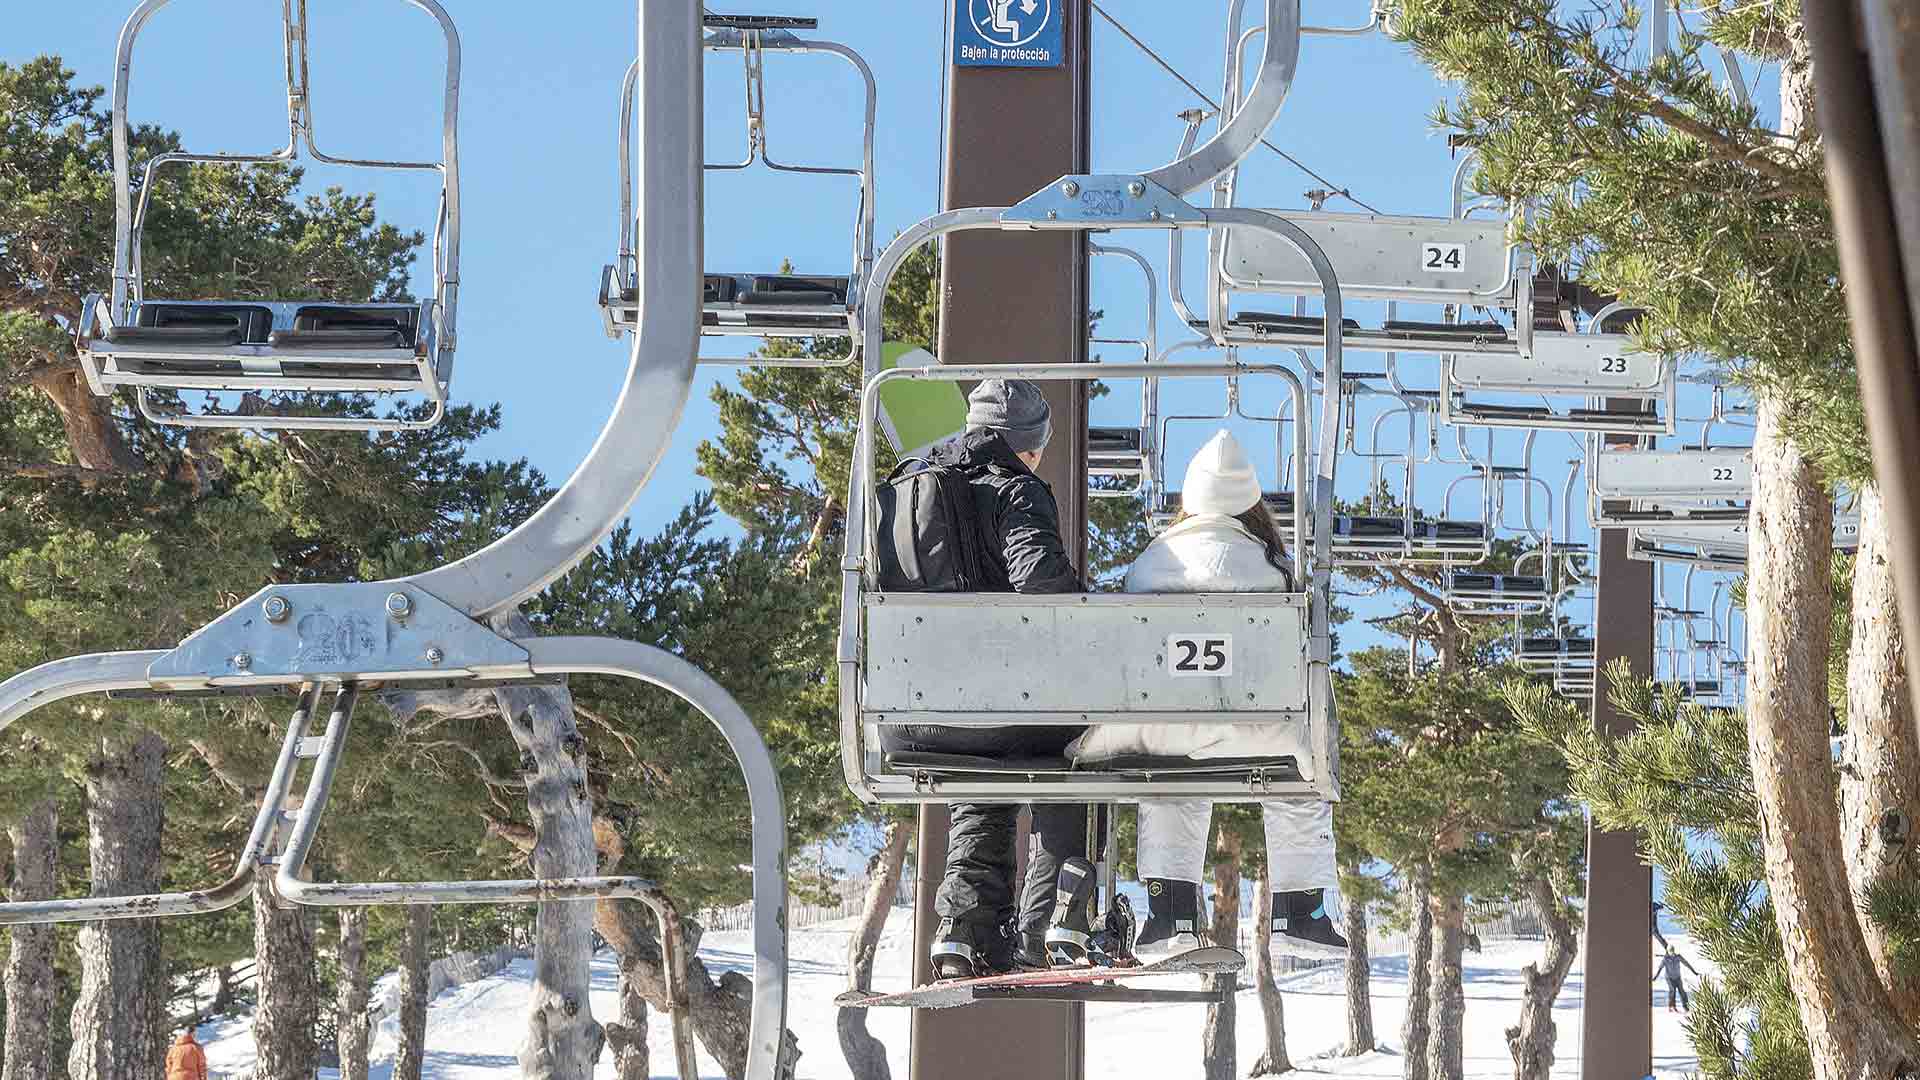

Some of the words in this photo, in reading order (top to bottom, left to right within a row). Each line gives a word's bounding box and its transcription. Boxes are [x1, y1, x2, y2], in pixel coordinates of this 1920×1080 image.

[961, 45, 987, 60] Bajen
[990, 46, 999, 58] la
[1001, 47, 1050, 62] protección
[1427, 247, 1461, 269] 24
[1601, 357, 1626, 373] 23
[1713, 468, 1733, 481] 22
[1844, 525, 1856, 535] 19
[1175, 639, 1226, 671] 25
